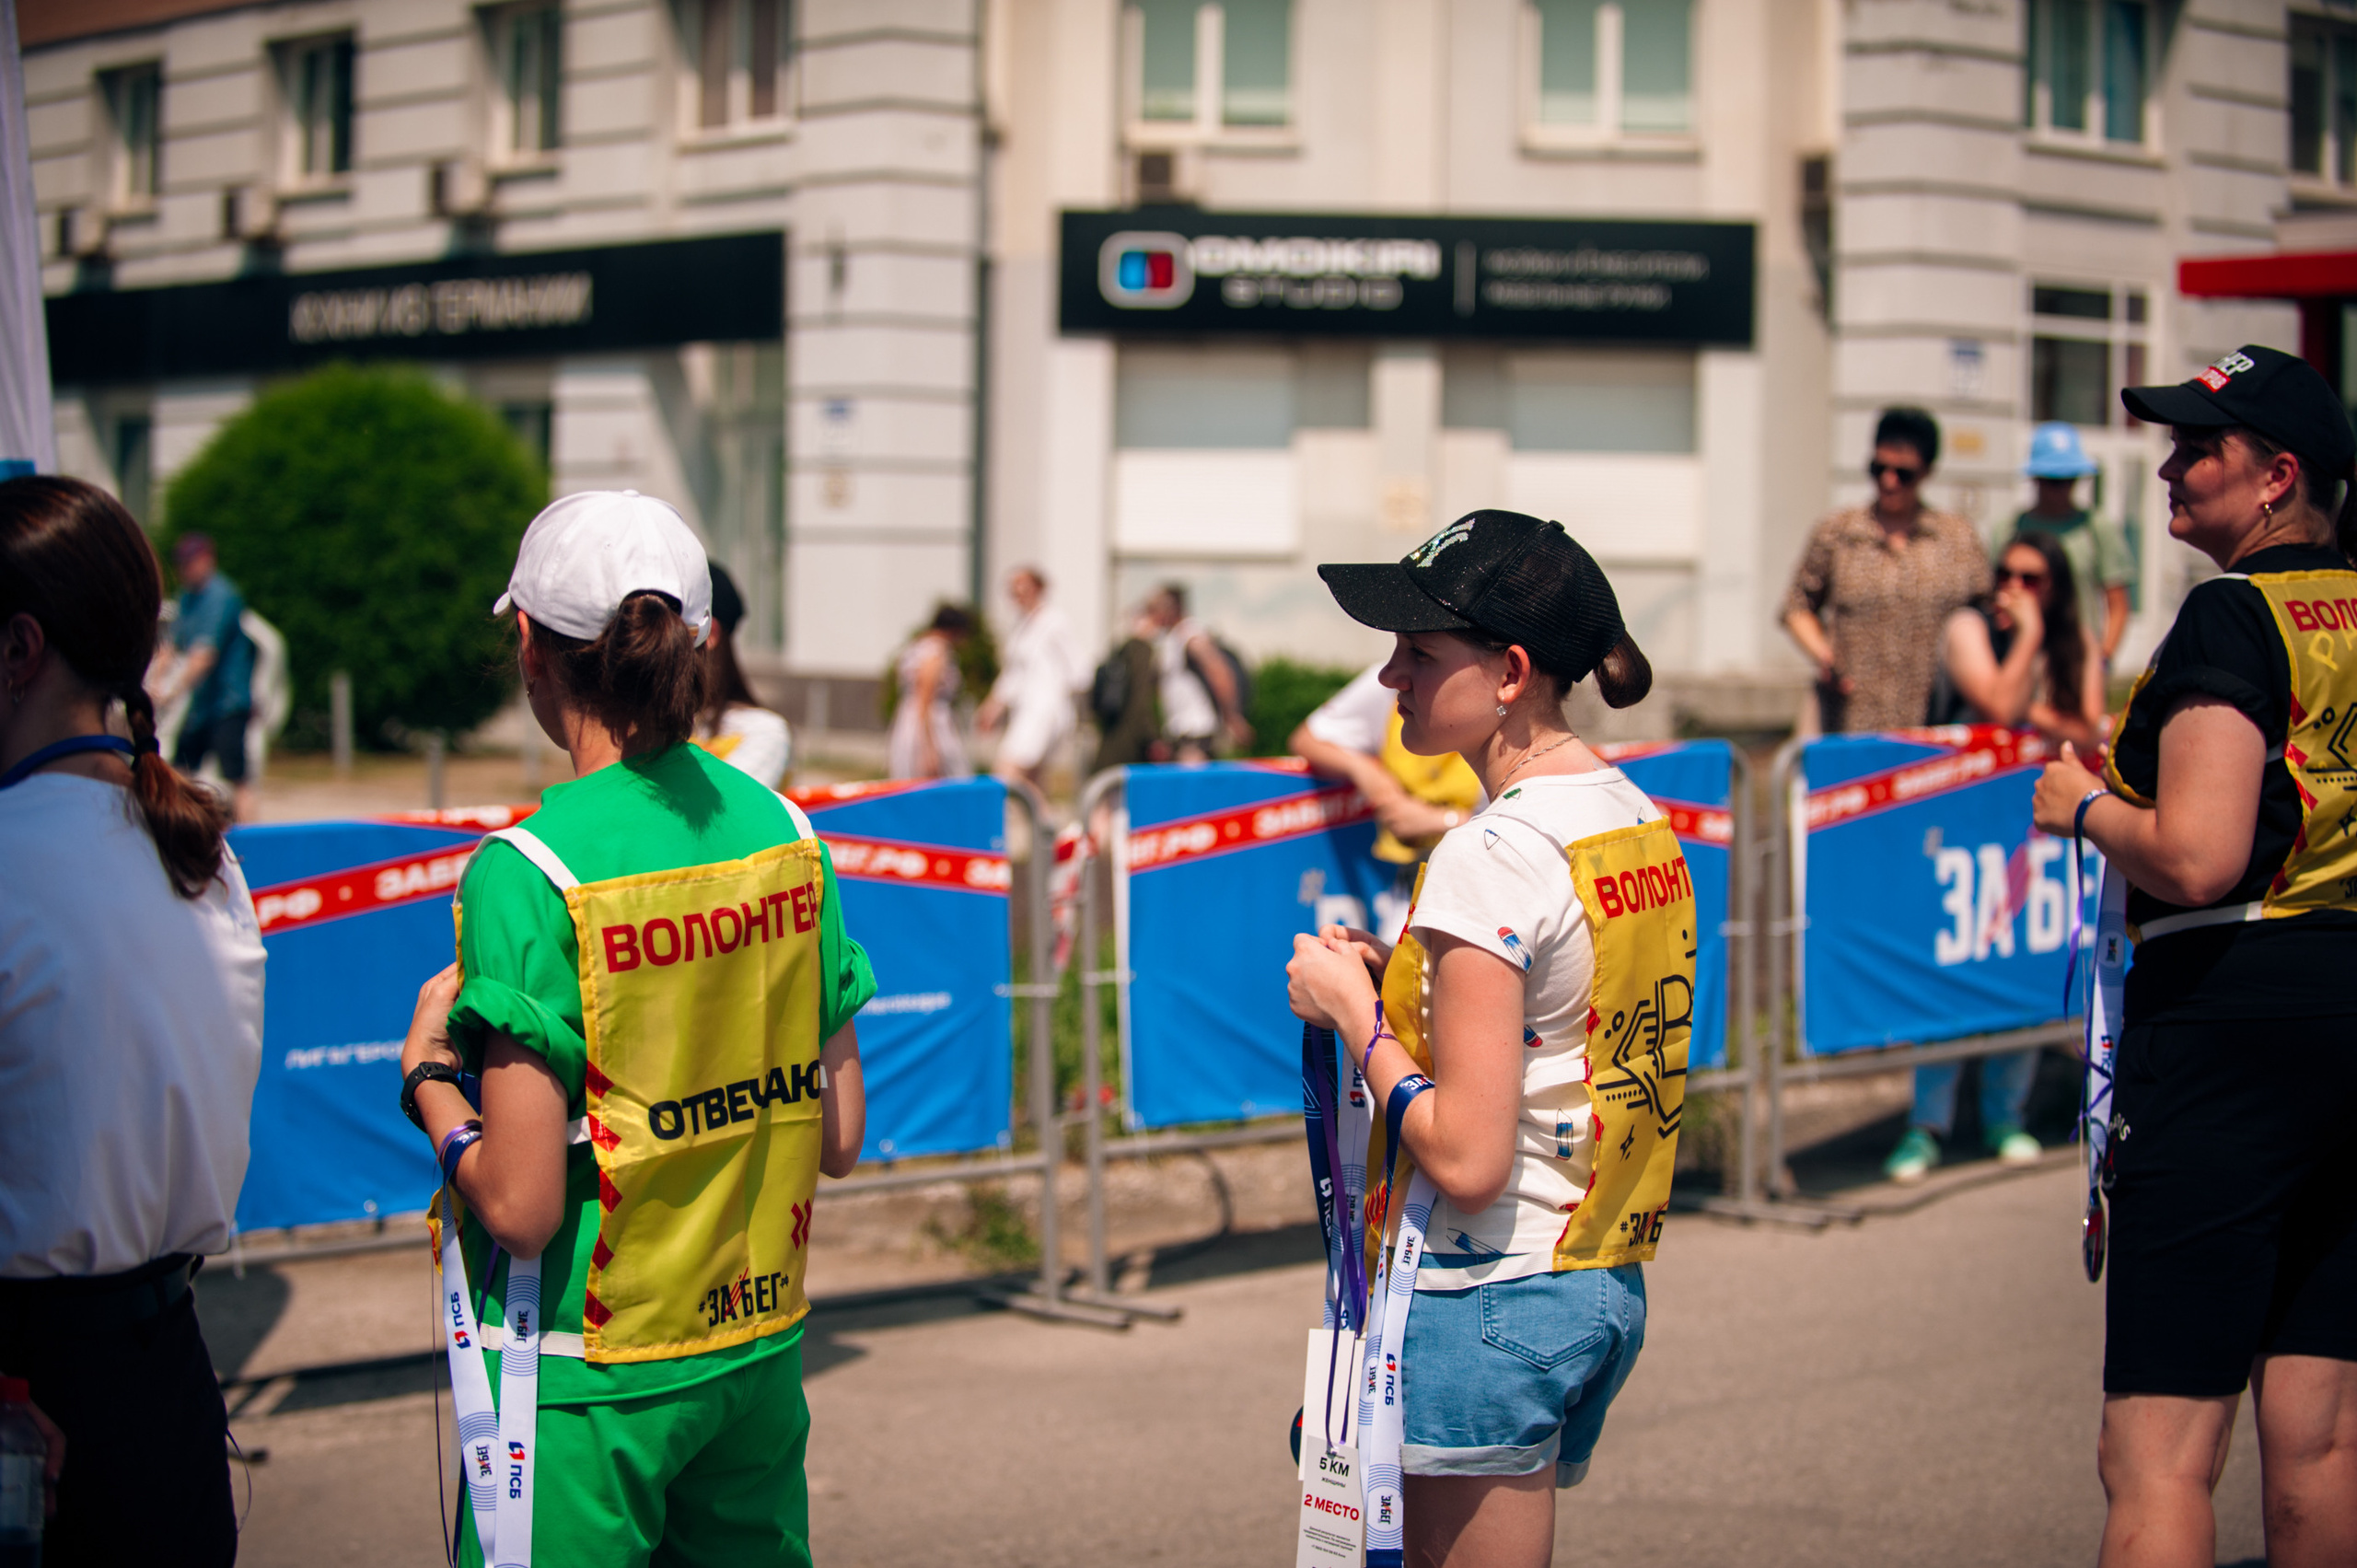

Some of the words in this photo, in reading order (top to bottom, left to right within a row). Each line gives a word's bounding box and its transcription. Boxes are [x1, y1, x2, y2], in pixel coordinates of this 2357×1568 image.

[2284, 598, 2357, 632] ВОЛ
[1594, 855, 1691, 919] ВОЛОНТ
[601, 881, 817, 973] ВОЛОНТЕР
[648, 1059, 819, 1141] ОТВЕЧАЮ
[450, 1291, 463, 1327] ПСБ
[1385, 1374, 1395, 1406] ПСБ
[509, 1464, 522, 1499] ПСБ
[1319, 1457, 1328, 1470] 5
[1329, 1459, 1350, 1477] КМ
[1304, 1493, 1313, 1507] 2
[1314, 1496, 1360, 1521] МЕСТО
